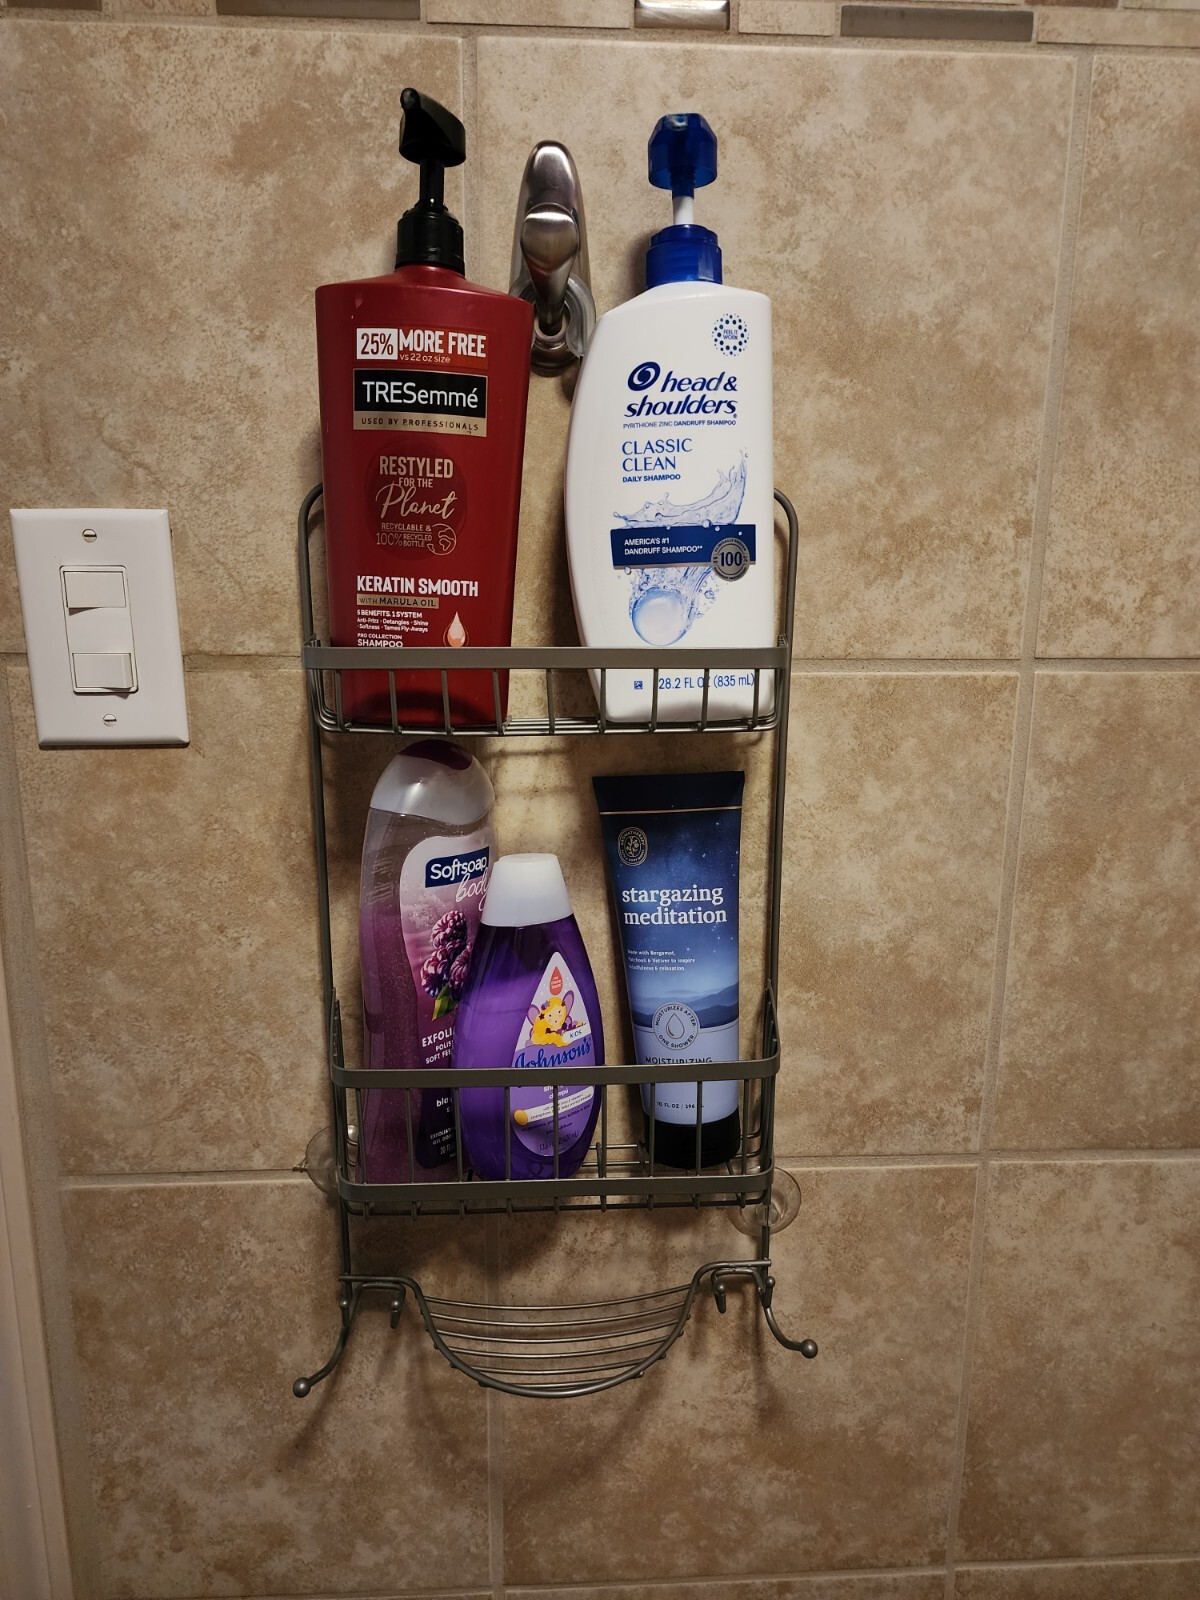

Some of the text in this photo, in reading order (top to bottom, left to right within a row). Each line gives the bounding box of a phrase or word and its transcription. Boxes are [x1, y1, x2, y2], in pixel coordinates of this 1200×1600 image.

[361, 329, 486, 357] 25% MORE FREE
[410, 353, 421, 361] 22
[434, 355, 450, 363] size
[660, 370, 738, 392] head &
[362, 381, 478, 408] TRESemmé
[624, 394, 738, 417] shoulders
[403, 419, 479, 430] PROFESSIONALS
[622, 438, 693, 455] CLASSIC
[380, 455, 453, 478] RESTYLED
[622, 456, 676, 472] CLEAN
[398, 477, 433, 488] FOR THE
[622, 475, 642, 483] DAILY
[376, 480, 458, 519] Planet
[381, 523, 423, 531] RECYCLABLE
[376, 532, 432, 546] 100% RECYCLED
[624, 538, 660, 546] AMERICA'S
[624, 547, 660, 555] DANDRUFF
[720, 552, 742, 566] 100
[357, 575, 478, 597] KERATIN SMOOTH
[379, 597, 418, 606] MARULA
[358, 639, 403, 647] SHAMPOO
[658, 678, 680, 689] 28.2
[684, 677, 694, 688] FL
[713, 674, 735, 688] (835
[738, 673, 755, 686] mL)
[430, 856, 487, 880] Softsoap
[456, 866, 488, 912] body
[622, 884, 723, 906] stargazing
[624, 906, 727, 925] meditation
[656, 1005, 696, 1027] MOISTURIZES AFTER
[659, 1034, 694, 1048] ONE SHOWER
[426, 1052, 440, 1064] SOFT
